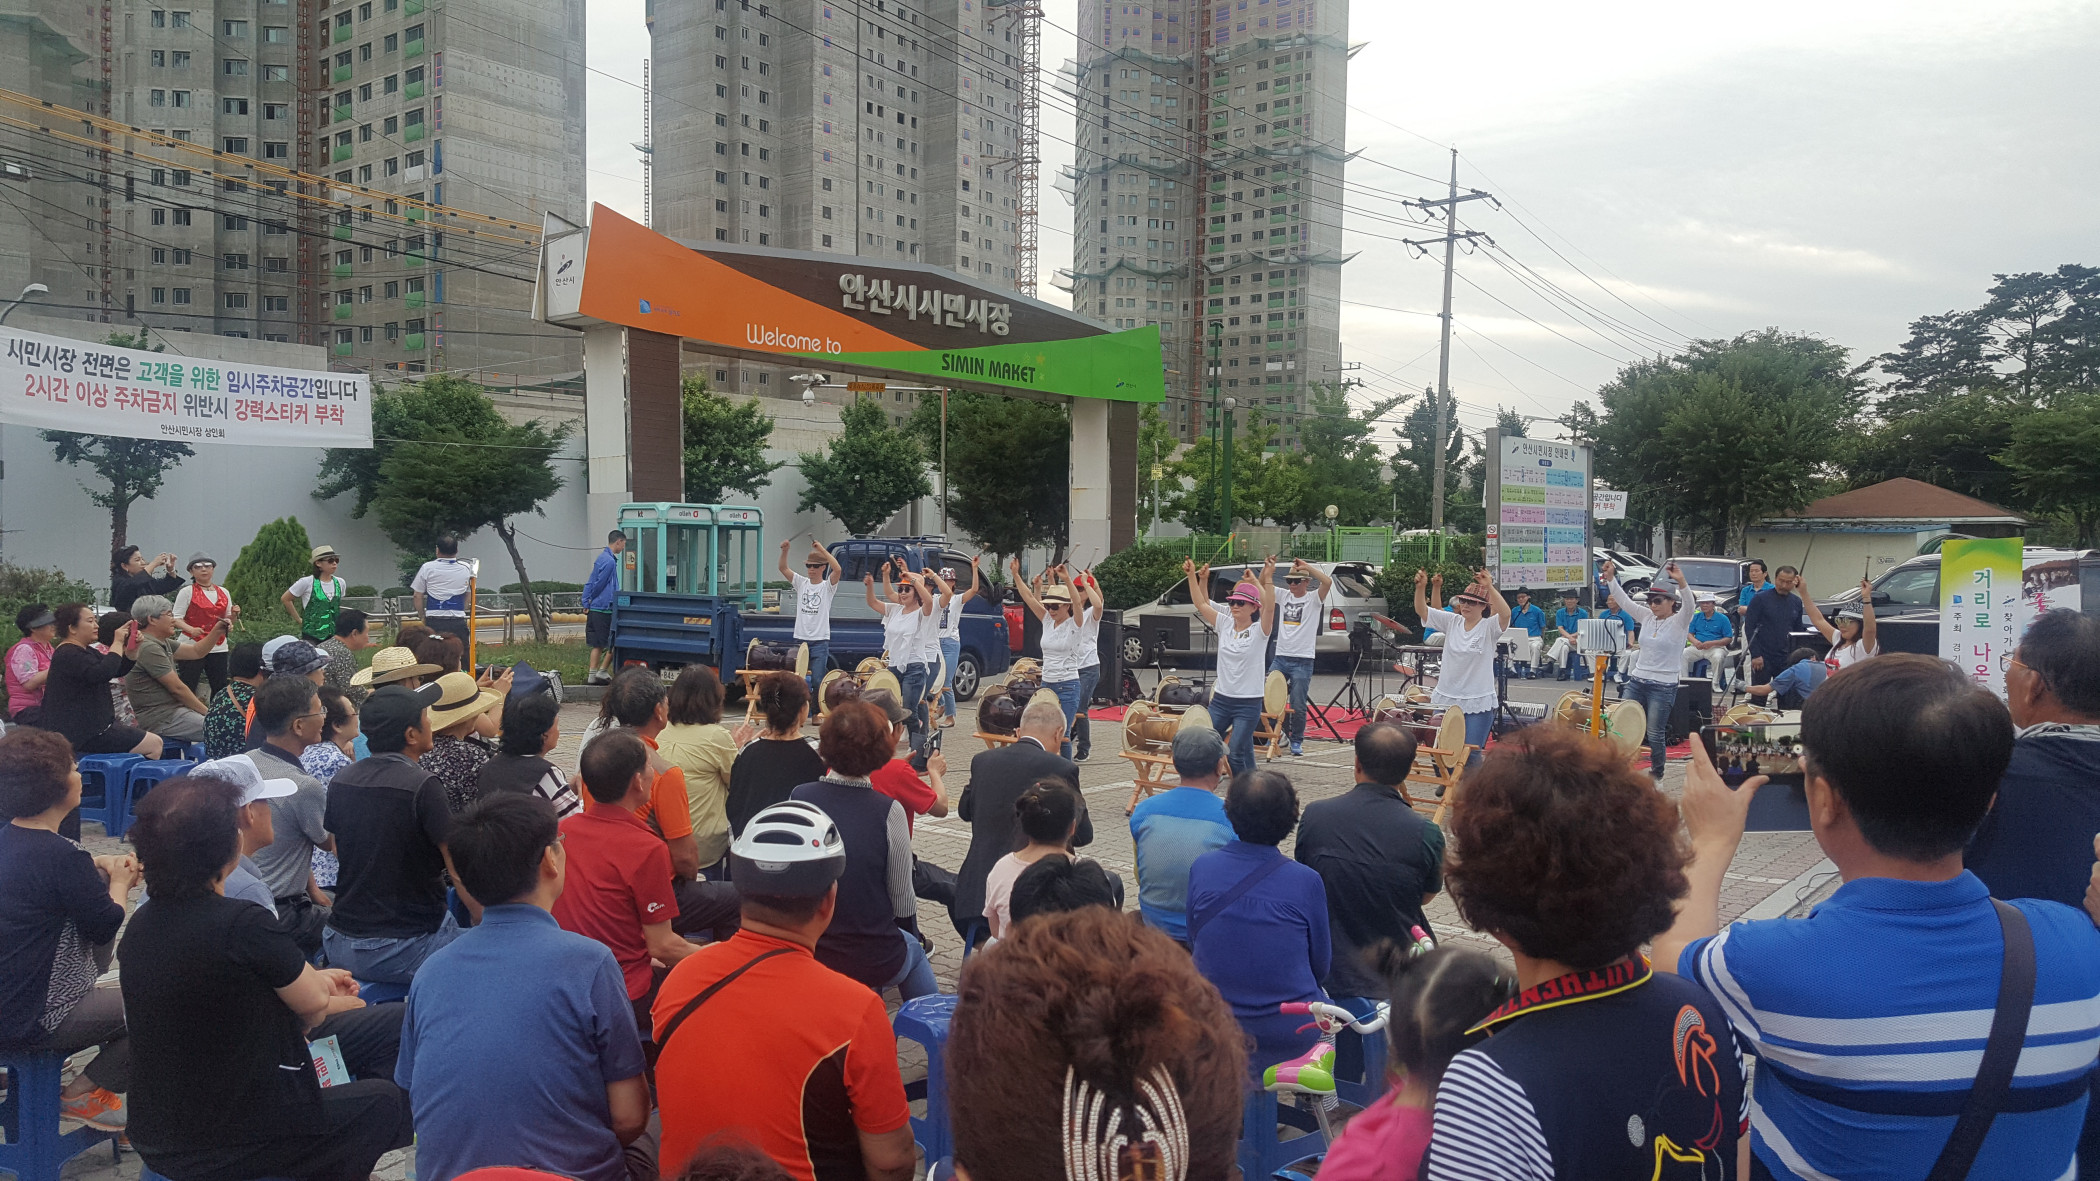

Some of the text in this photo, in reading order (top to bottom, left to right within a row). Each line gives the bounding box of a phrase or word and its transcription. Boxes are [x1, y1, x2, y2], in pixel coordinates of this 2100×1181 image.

[555, 276, 575, 287] 안산시
[839, 273, 1013, 336] 안산시시민시장
[746, 323, 842, 355] Welcome to
[7, 338, 358, 401] 시민시장 전면은 고객을 위한 임시주차공간입니다
[941, 353, 1036, 383] SIMIN MAKET
[25, 373, 345, 426] 2시간 이상 주차금지 위반시 강력스티커 부착
[160, 424, 226, 438] 안산시민시장 상인회
[1603, 502, 1616, 511] 부착
[1953, 612, 1962, 633] 주최
[1973, 569, 1991, 683] 거리로 나온
